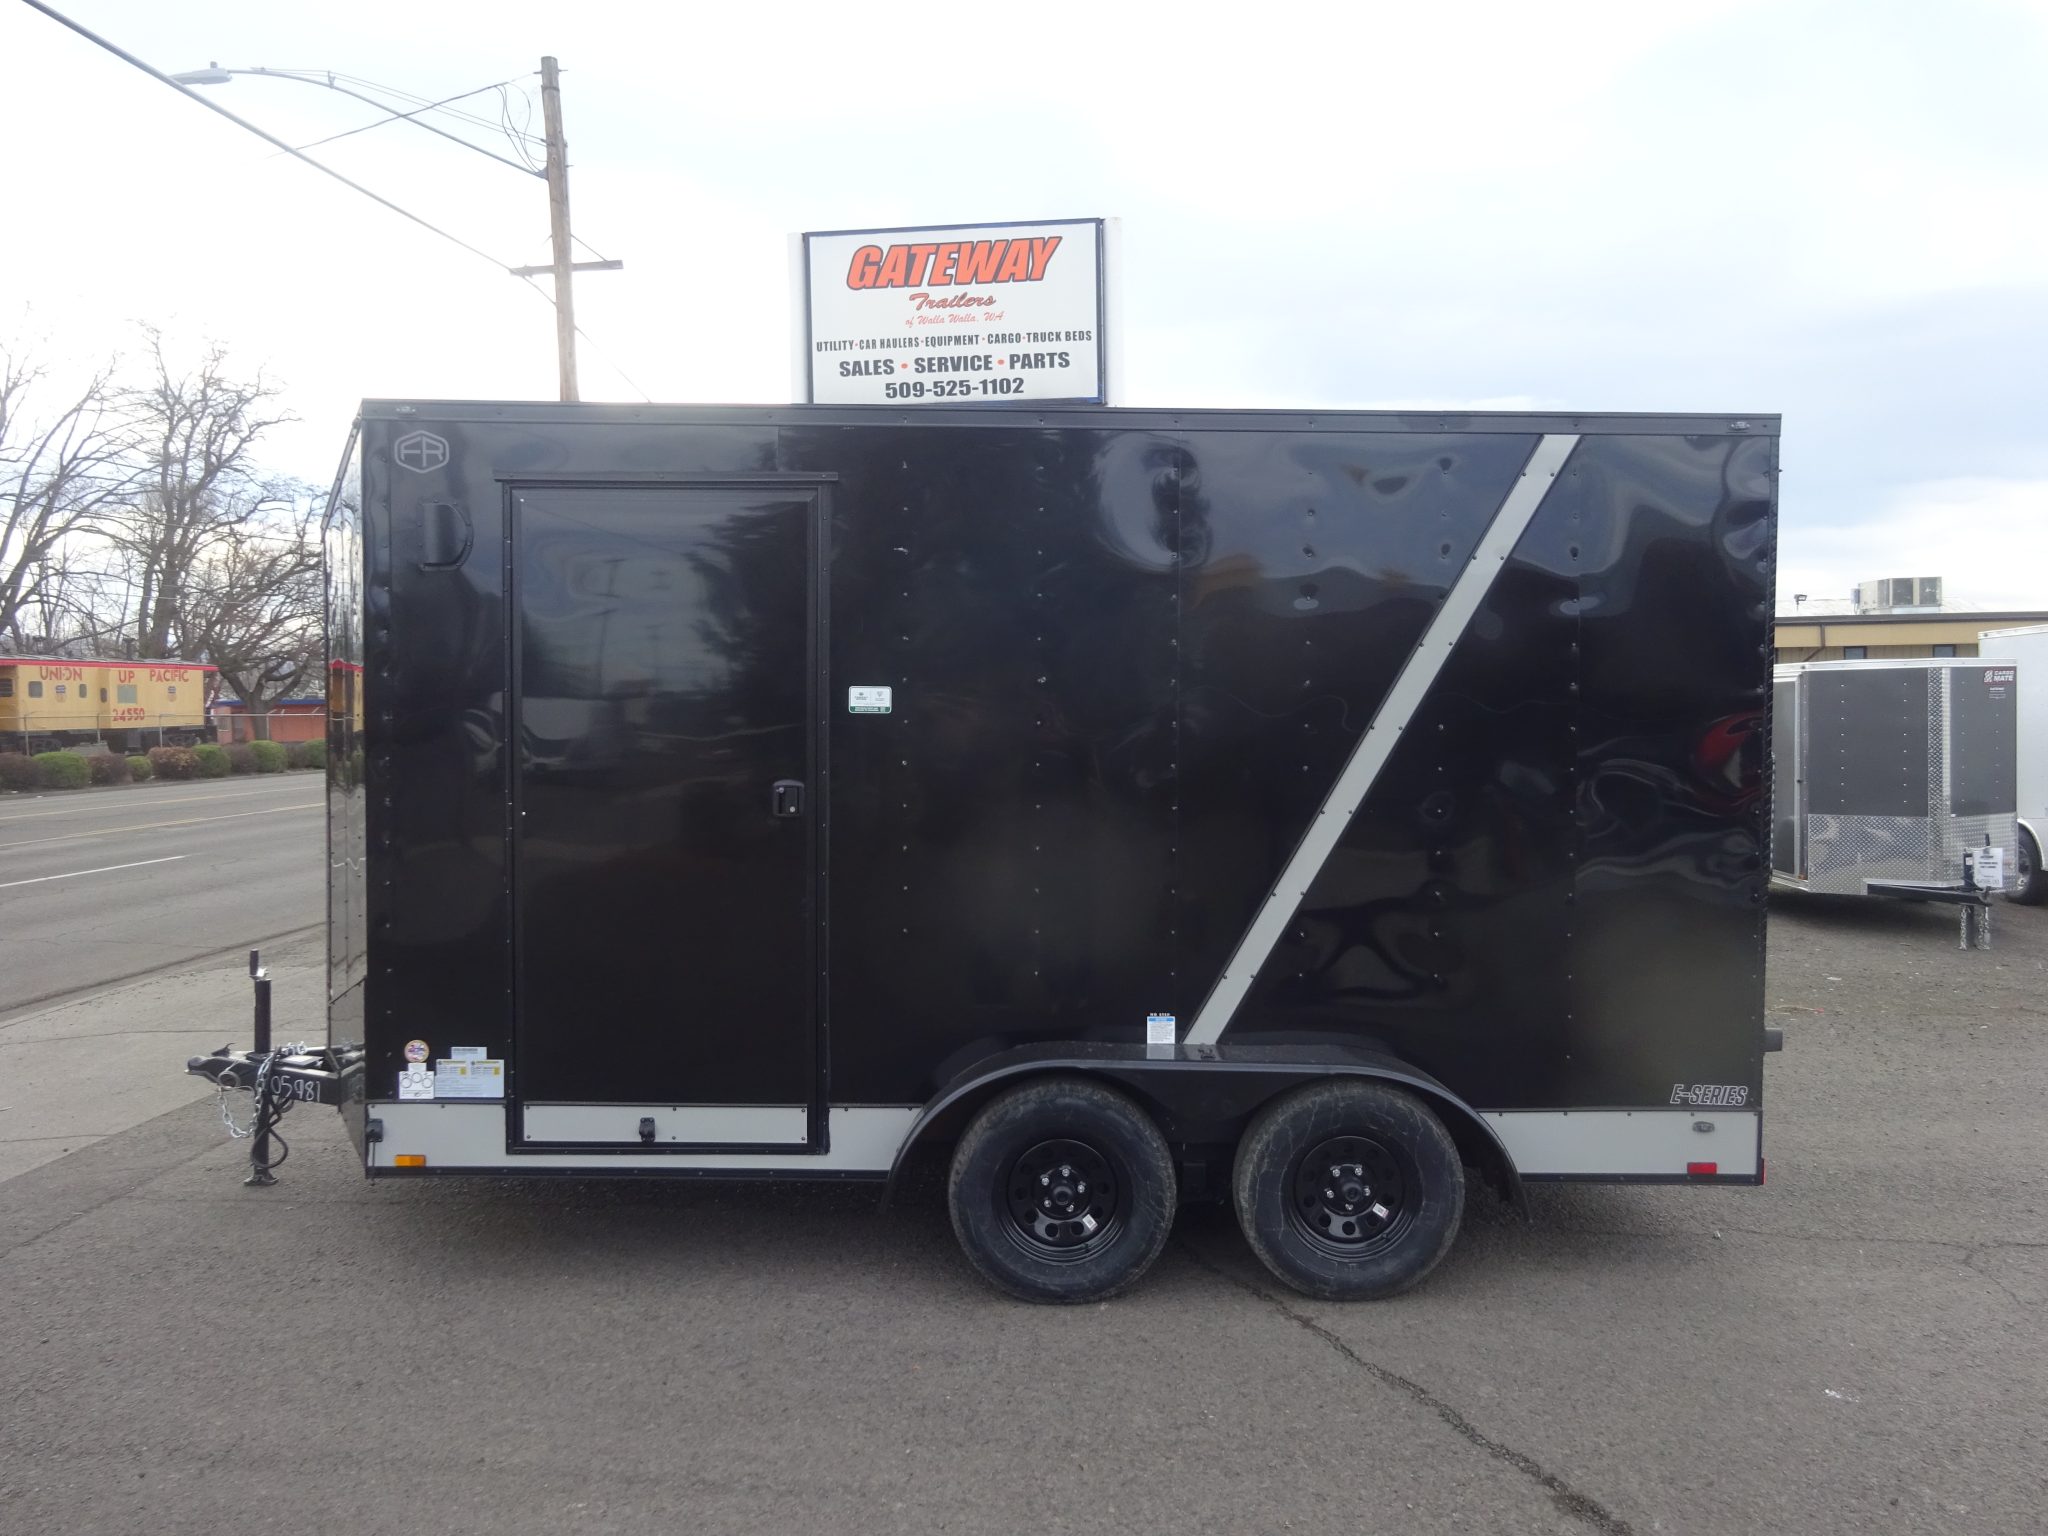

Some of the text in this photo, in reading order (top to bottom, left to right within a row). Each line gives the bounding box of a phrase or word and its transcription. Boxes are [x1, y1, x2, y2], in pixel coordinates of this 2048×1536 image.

[847, 236, 1063, 290] GATEWAY
[909, 292, 997, 311] Trailers
[917, 315, 945, 325] Walla
[983, 310, 1005, 322] WA
[816, 330, 1092, 352] UTILITY CAR HAULERS EQUIPMENT CARGO TRUCK BEDS
[839, 352, 1070, 377] SALES SERVICE PARTS
[885, 377, 1025, 399] 509-525-1102
[40, 666, 82, 681] UNION
[118, 670, 135, 683] UP
[150, 670, 189, 682] PACIFIC
[271, 1075, 320, 1103] 05981
[1670, 1084, 1748, 1106] E-SERIES
